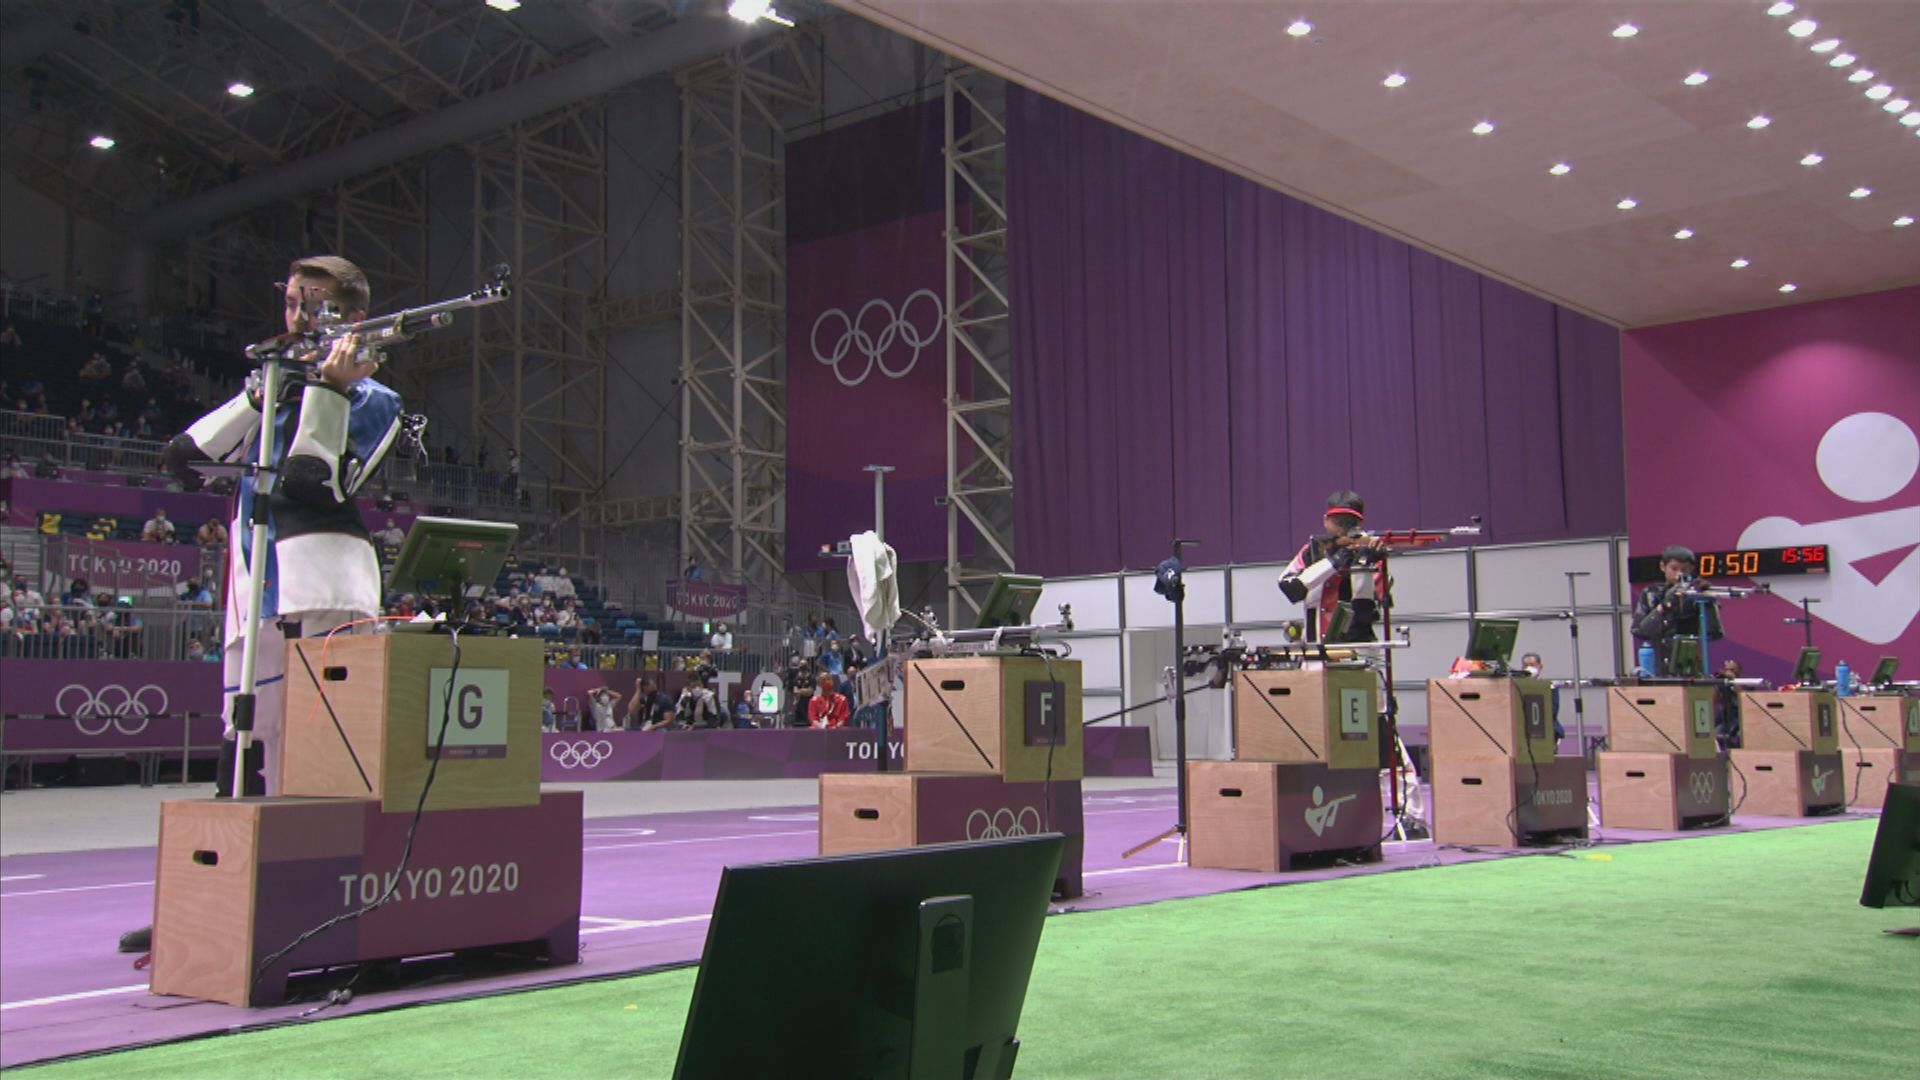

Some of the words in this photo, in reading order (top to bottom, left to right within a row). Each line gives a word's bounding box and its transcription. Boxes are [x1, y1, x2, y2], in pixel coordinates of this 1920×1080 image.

[1700, 552, 1758, 576] 0:50
[1782, 546, 1825, 564] 15:56
[457, 684, 483, 729] G
[1041, 692, 1053, 725] F
[1350, 697, 1360, 723] E
[1531, 702, 1540, 725] D
[846, 742, 904, 759] TOY
[339, 867, 442, 907] TOKYO
[450, 862, 519, 896] 2020
